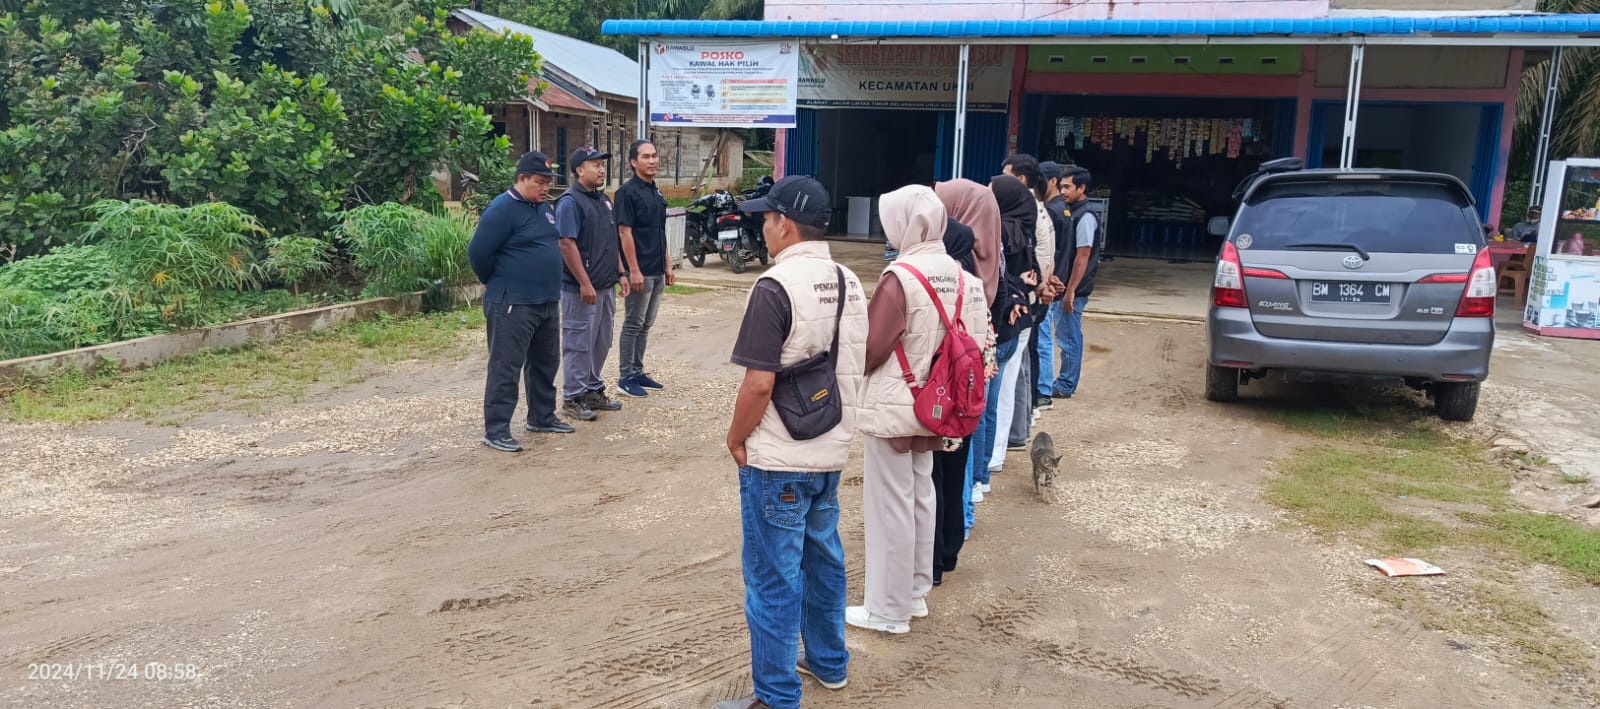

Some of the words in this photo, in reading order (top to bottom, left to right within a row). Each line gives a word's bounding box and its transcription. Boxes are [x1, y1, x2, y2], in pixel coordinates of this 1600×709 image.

[701, 51, 745, 60] POSKO
[858, 81, 938, 92] KECAMATAN
[942, 82, 974, 93] UKI
[1312, 282, 1329, 296] BM
[1339, 283, 1364, 296] 1364
[1374, 283, 1391, 297] CM
